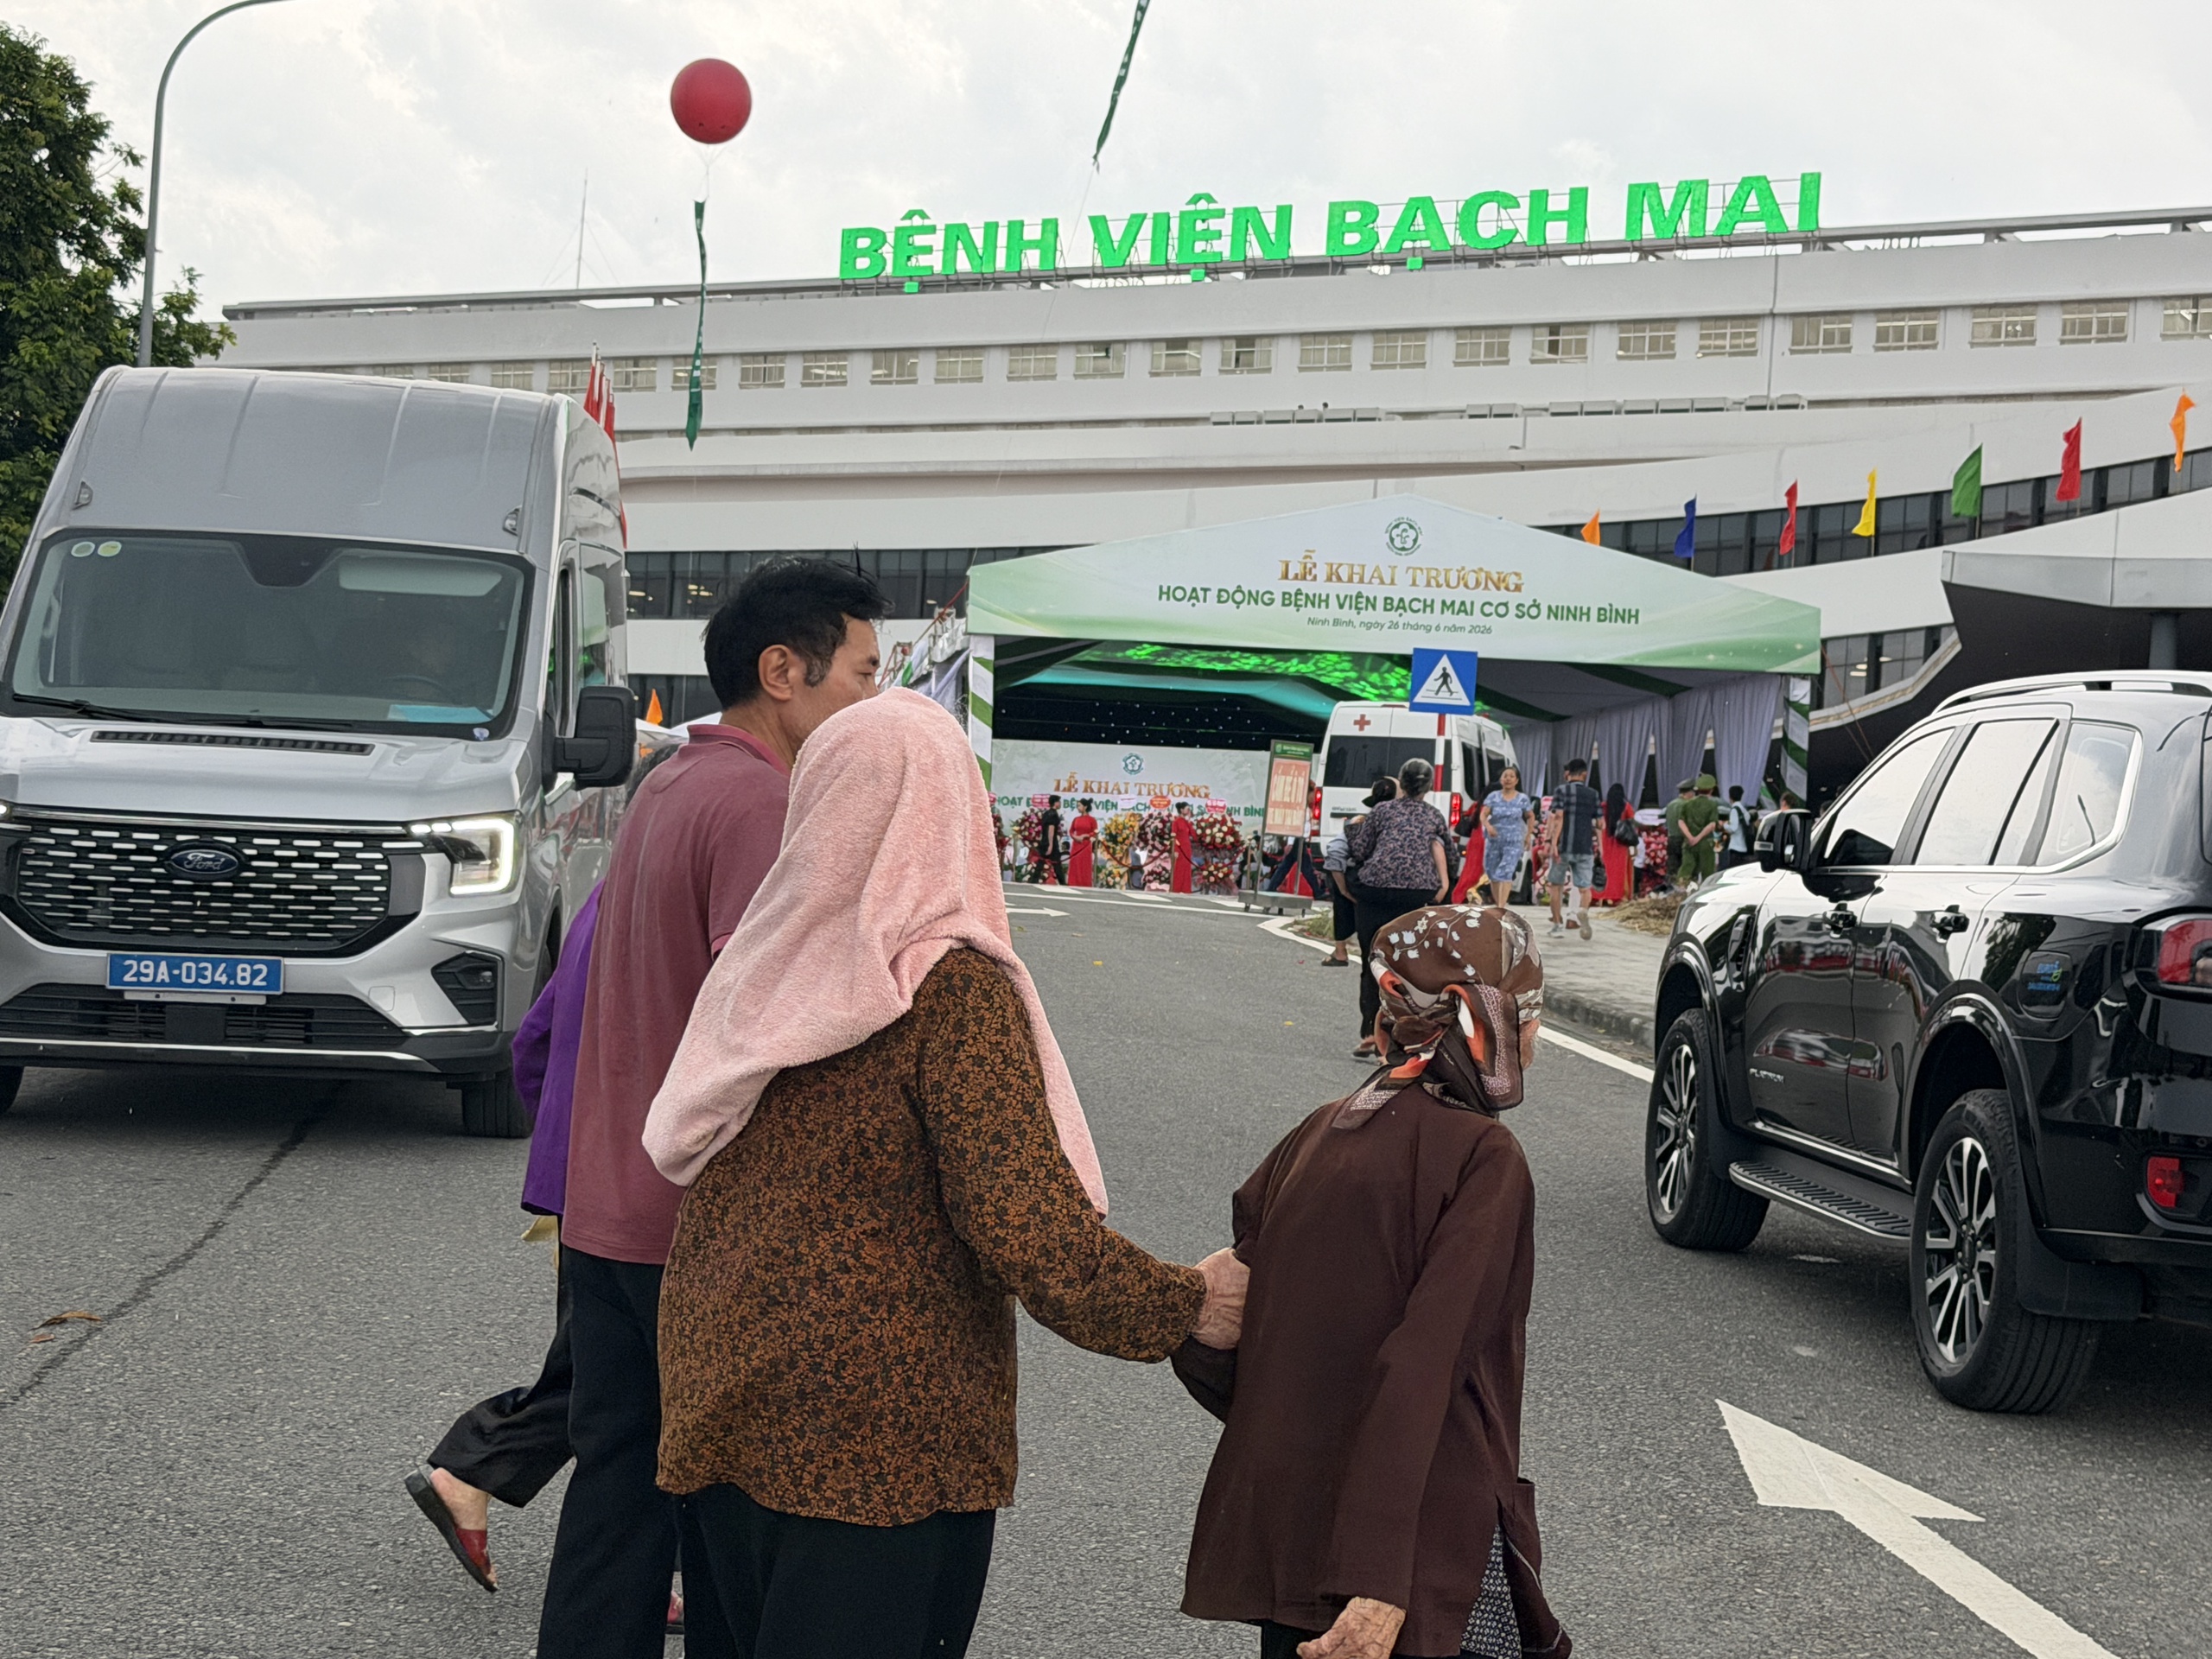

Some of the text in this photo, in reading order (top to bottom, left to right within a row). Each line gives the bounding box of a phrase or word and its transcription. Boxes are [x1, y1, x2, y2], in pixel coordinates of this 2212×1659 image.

[840, 173, 1821, 295] BỆNH VIỆN BẠCH MAI
[1278, 549, 1524, 593] LỄ KHAI TRƯƠNG
[1158, 584, 1640, 625] HOẠT ĐỘNG BỆNH VIỆN BẠCH MAI CƠ SỞ NINH BÌNH
[1307, 617, 1330, 627] Ninh
[1359, 620, 1386, 632] ngày
[1387, 620, 1400, 630] 26
[1402, 621, 1433, 633] tháng
[1434, 622, 1441, 632] 6
[1443, 623, 1466, 633] năm
[1468, 625, 1493, 634] 2026
[1053, 772, 1211, 798] LỄ KHAI TRƯƠNG
[1094, 798, 1118, 813] VIỆN
[183, 852, 226, 870] Ford
[122, 959, 268, 987] 29A-034.82
